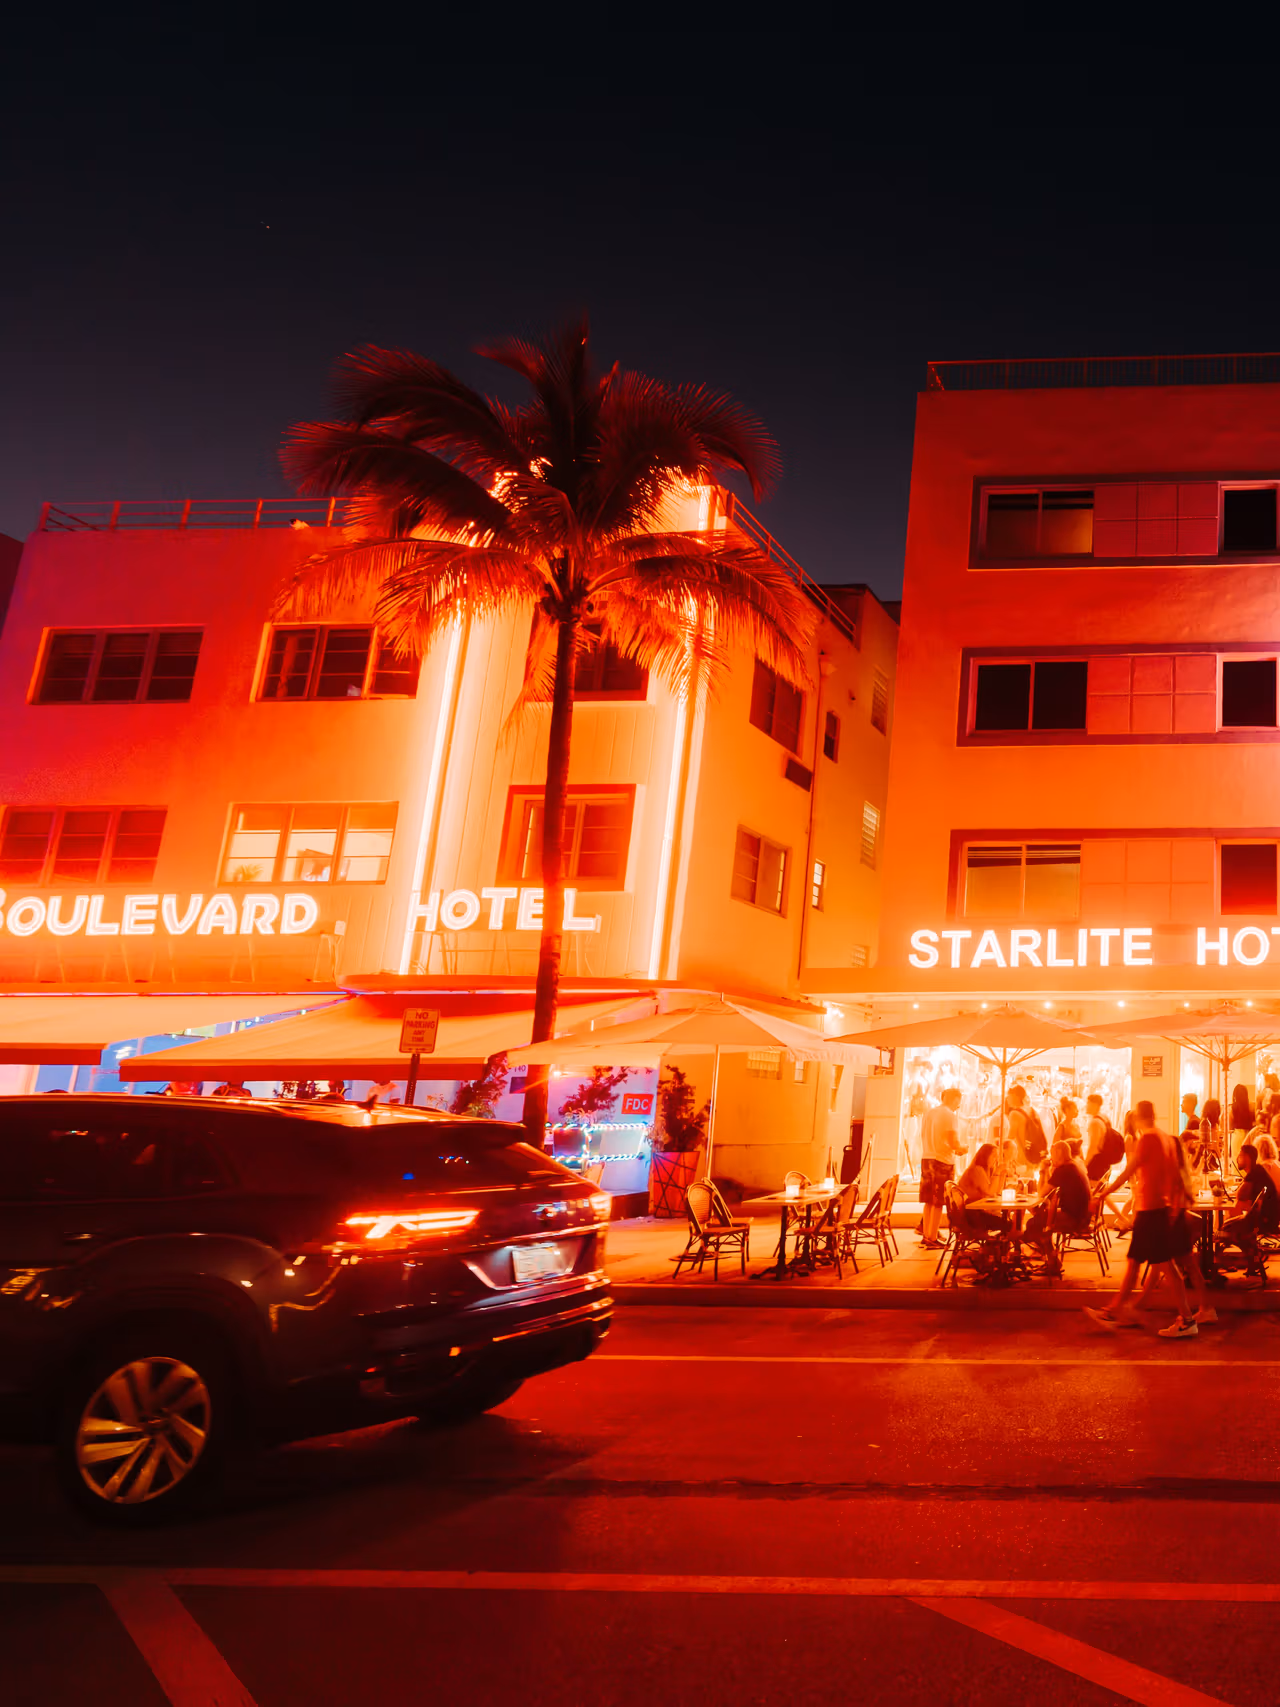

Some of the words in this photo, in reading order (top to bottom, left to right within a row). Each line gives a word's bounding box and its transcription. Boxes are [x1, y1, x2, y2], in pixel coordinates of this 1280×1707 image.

[408, 887, 599, 931] HOTEL
[908, 927, 1153, 968] STARLITE
[415, 1011, 429, 1020] NO
[406, 1021, 436, 1029] PARKING
[625, 1098, 649, 1111] FDC
